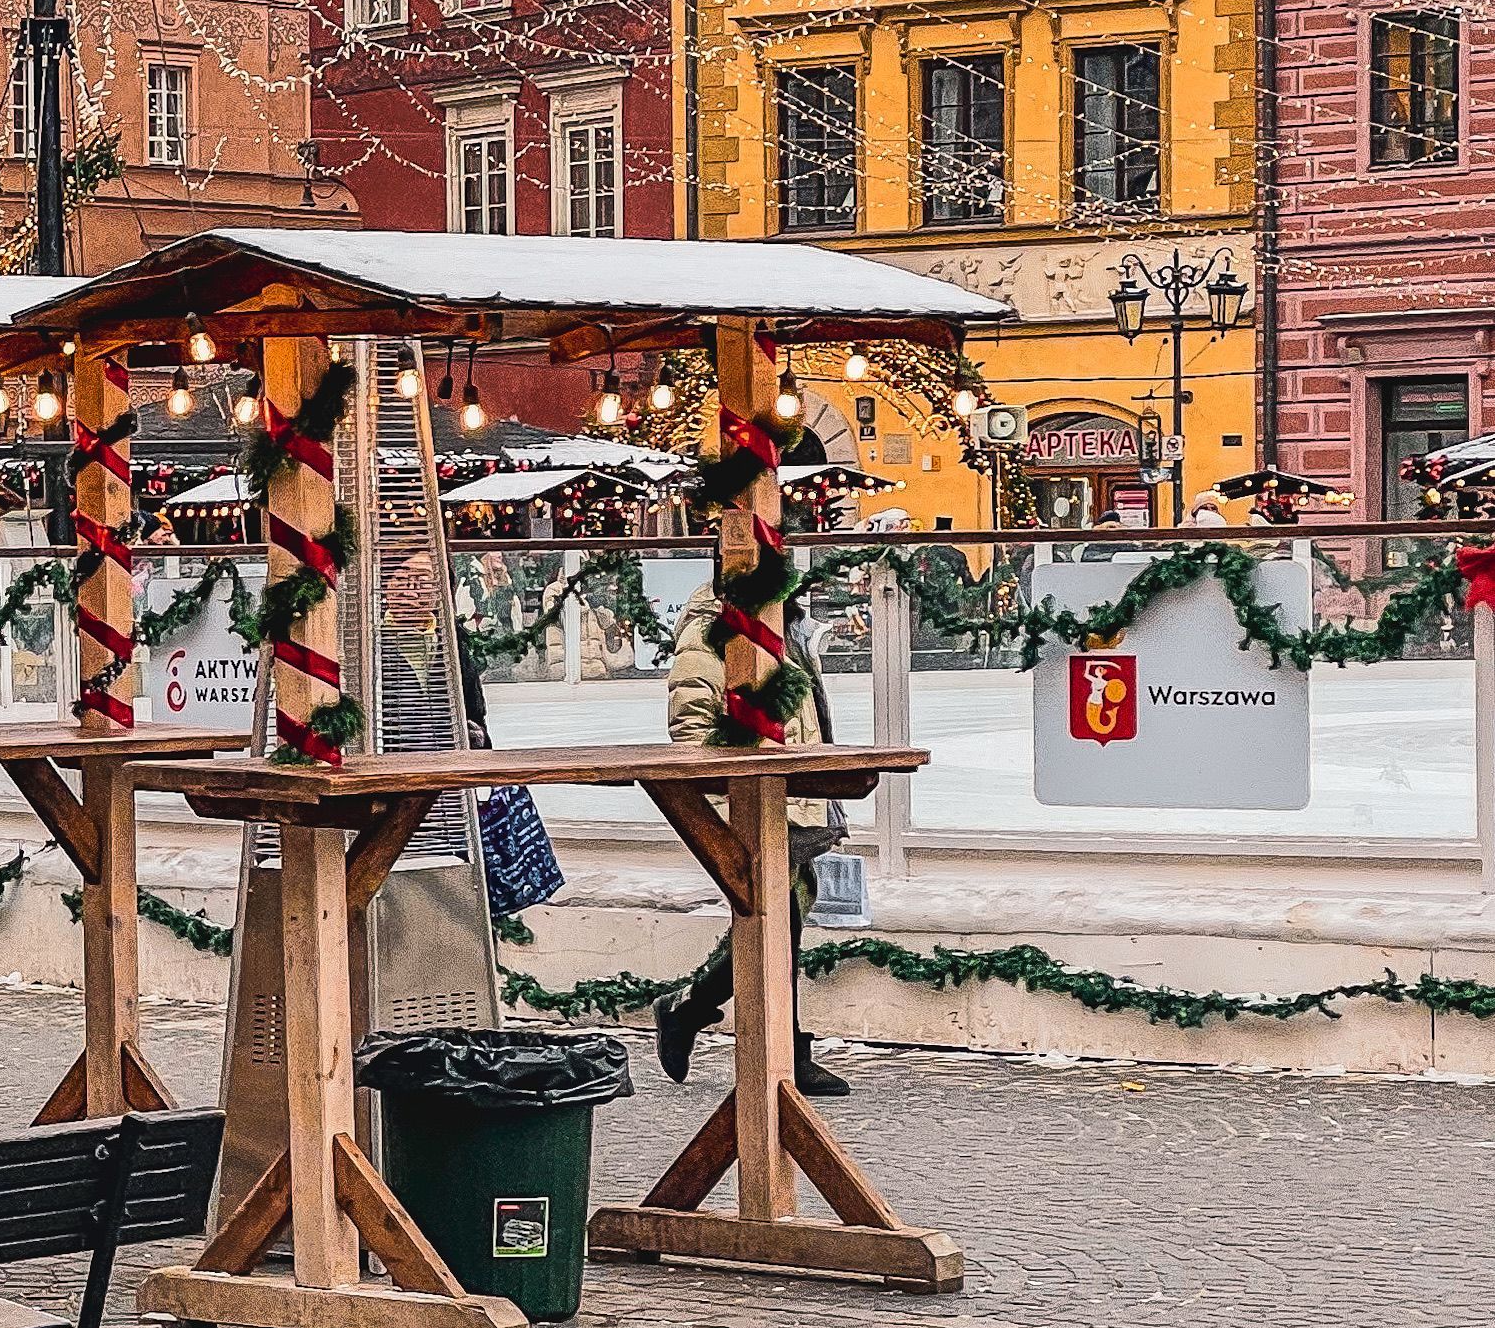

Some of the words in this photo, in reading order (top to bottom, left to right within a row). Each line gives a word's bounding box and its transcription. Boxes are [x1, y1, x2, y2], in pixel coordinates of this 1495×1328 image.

[1026, 429, 1138, 459] APTEKA
[195, 659, 259, 679] AKTYW
[195, 687, 257, 703] WARSZ
[1148, 685, 1275, 705] Warszawa
